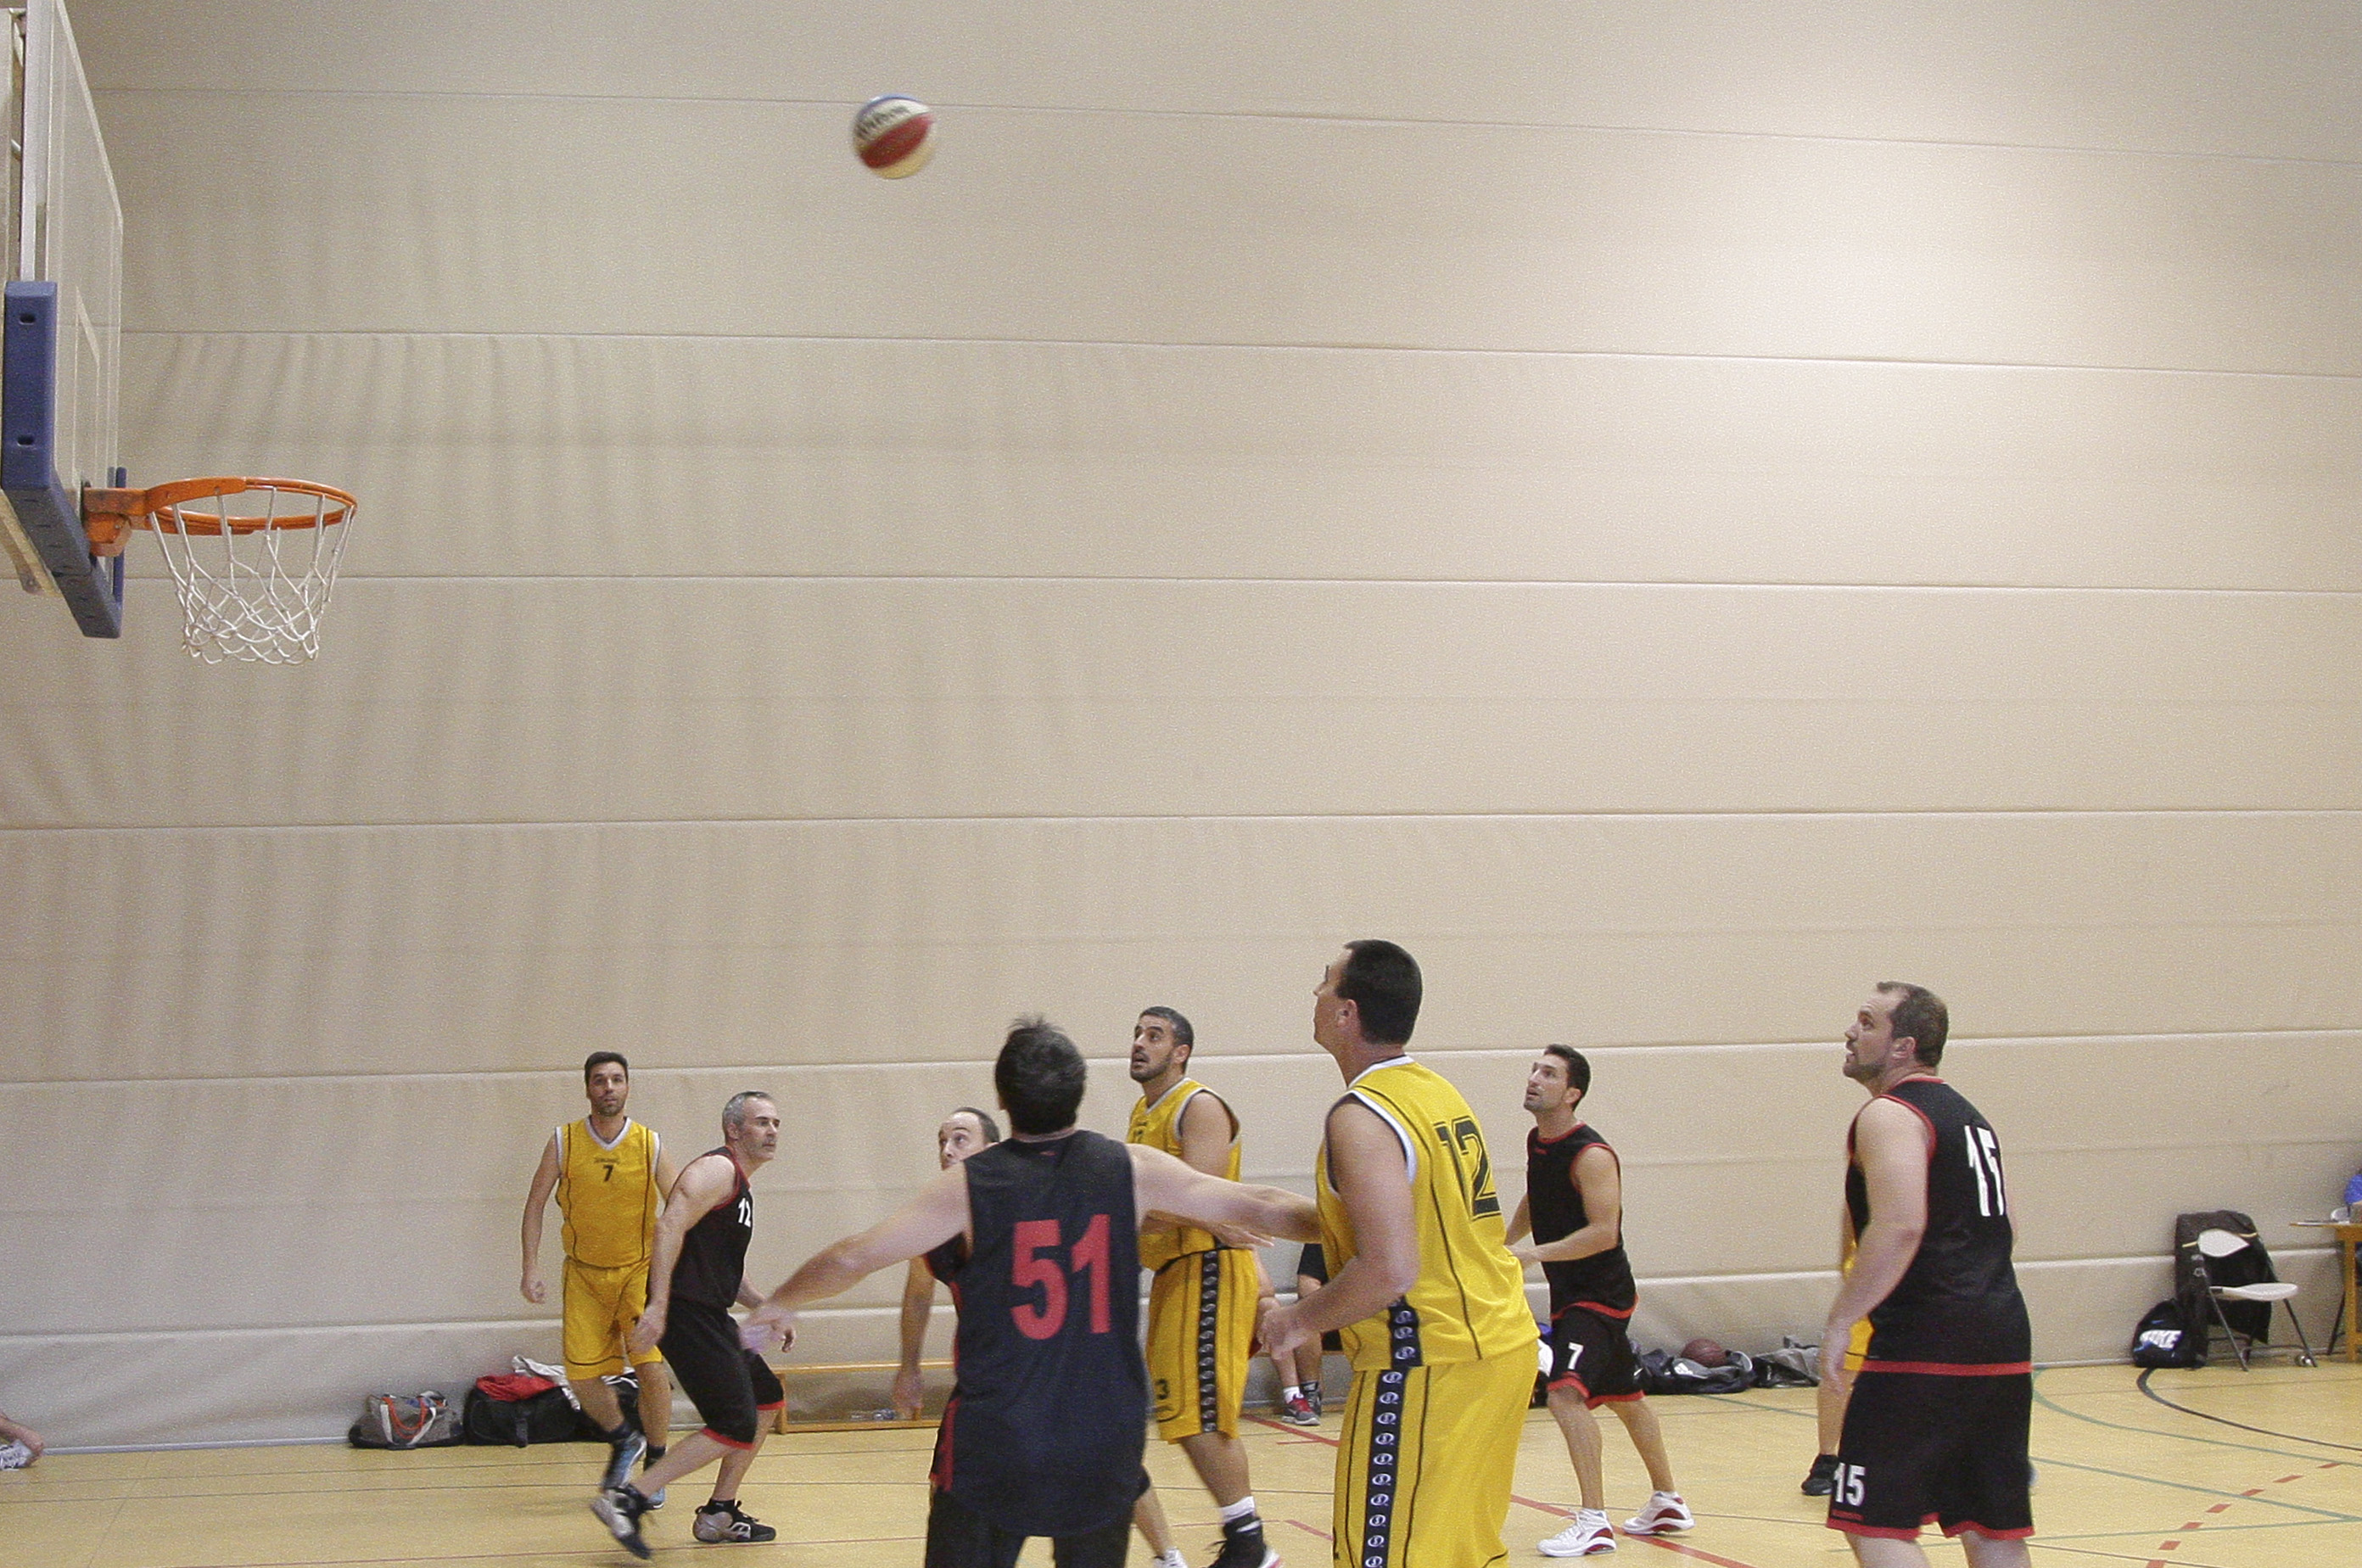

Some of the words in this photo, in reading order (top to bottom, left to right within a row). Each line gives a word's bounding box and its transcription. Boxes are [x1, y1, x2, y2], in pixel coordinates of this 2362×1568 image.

[603, 1165, 613, 1182] 7
[1433, 1116, 1502, 1222] 12
[738, 1197, 751, 1228] 12
[1010, 1213, 1111, 1340] 51
[1568, 1341, 1583, 1369] 7
[1834, 1462, 1866, 1507] 15
